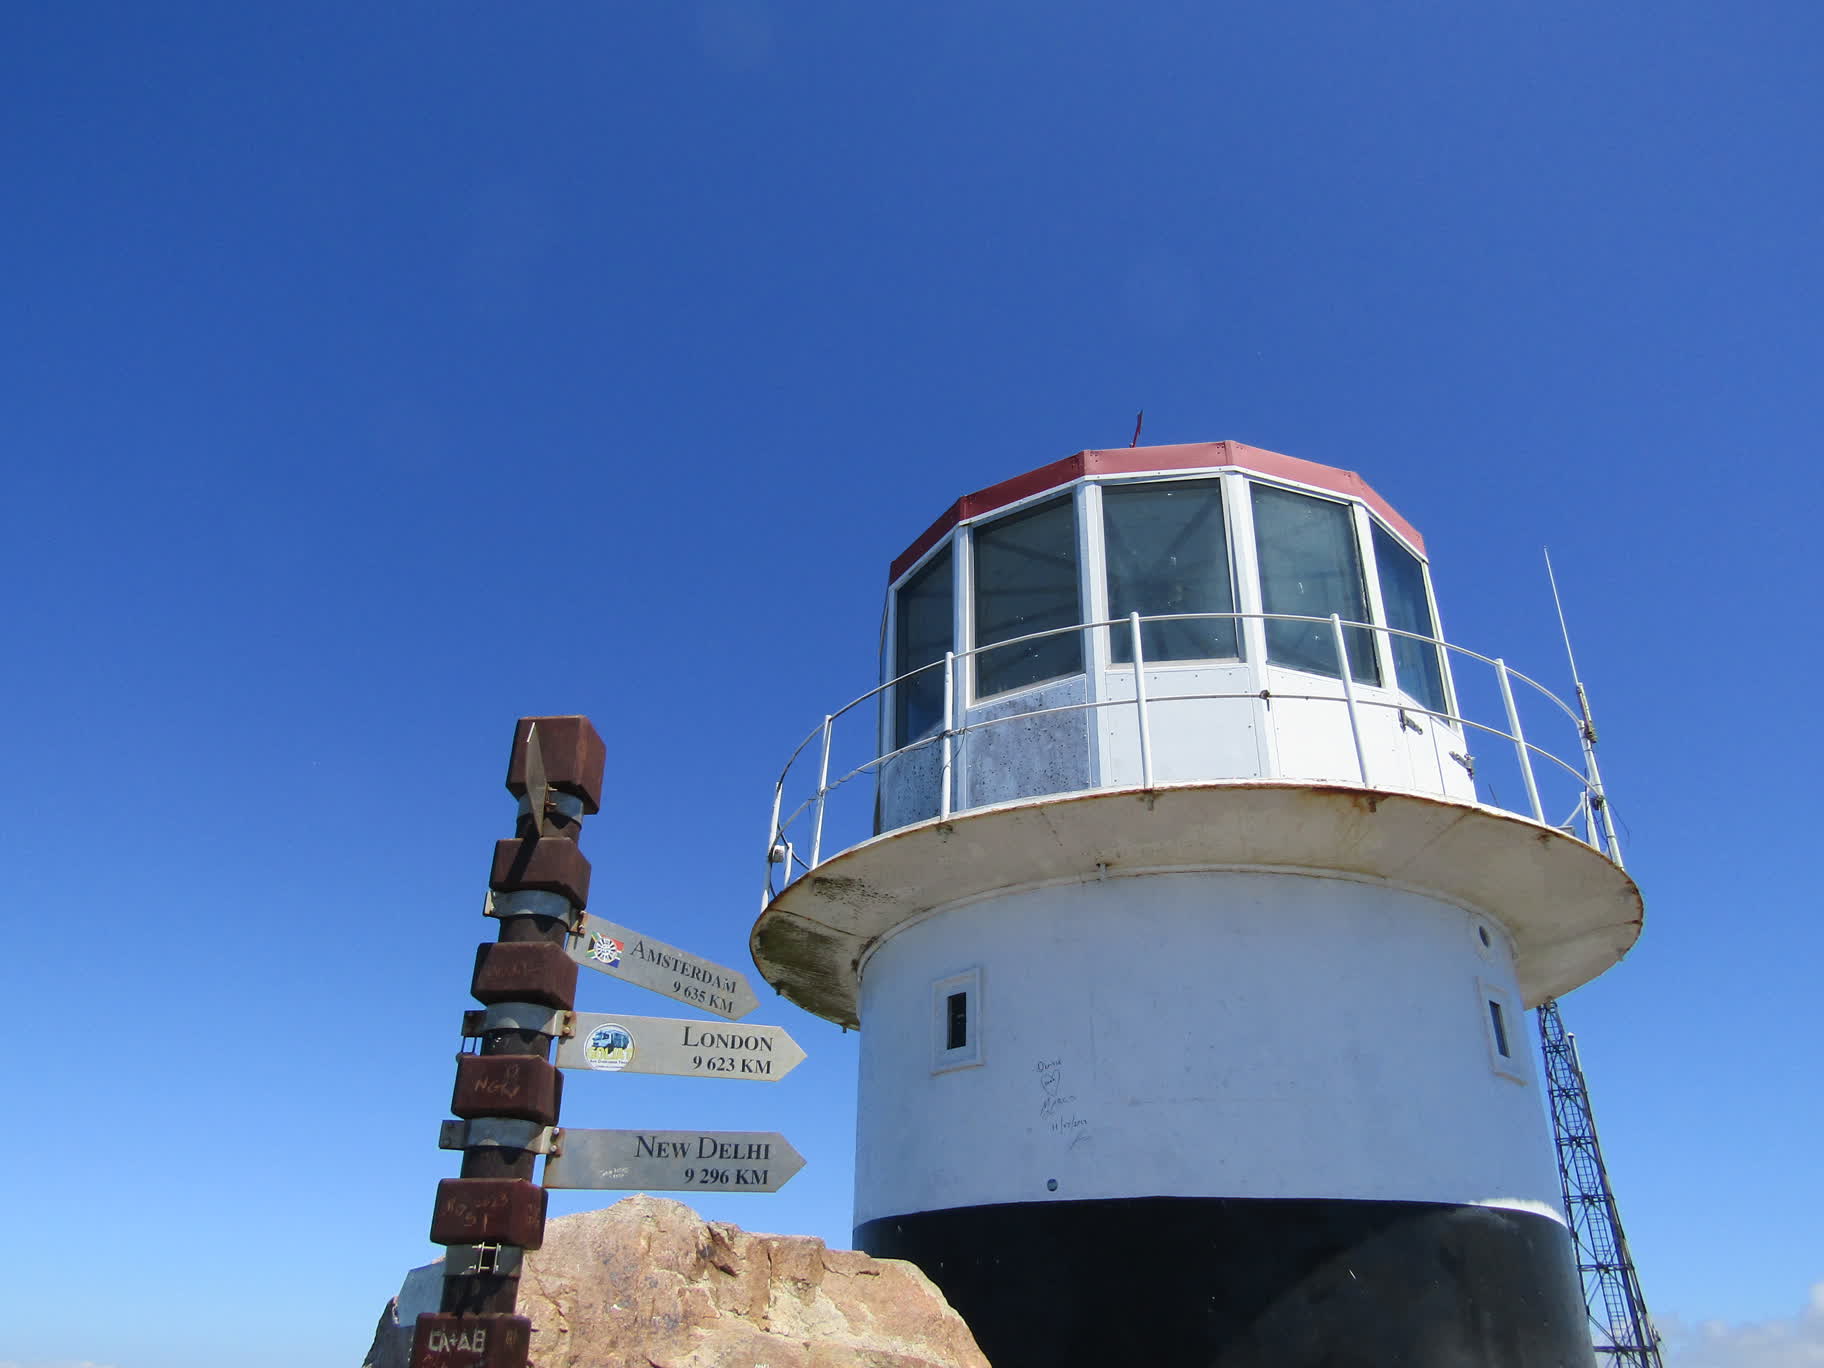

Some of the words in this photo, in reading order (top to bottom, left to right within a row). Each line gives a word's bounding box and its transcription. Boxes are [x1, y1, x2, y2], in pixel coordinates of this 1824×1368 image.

[630, 940, 737, 994] AMSTERDAM
[673, 980, 681, 993] 9
[684, 985, 706, 1003] 635
[709, 994, 733, 1013] KM
[682, 1026, 773, 1052] LONDON
[693, 1055, 702, 1070] 9
[707, 1057, 735, 1072] 623
[740, 1059, 772, 1074] KM
[634, 1135, 691, 1159] NEW
[697, 1137, 770, 1160] DELHI
[684, 1168, 694, 1184] 9
[699, 1169, 729, 1185] 296
[735, 1170, 768, 1185] KM
